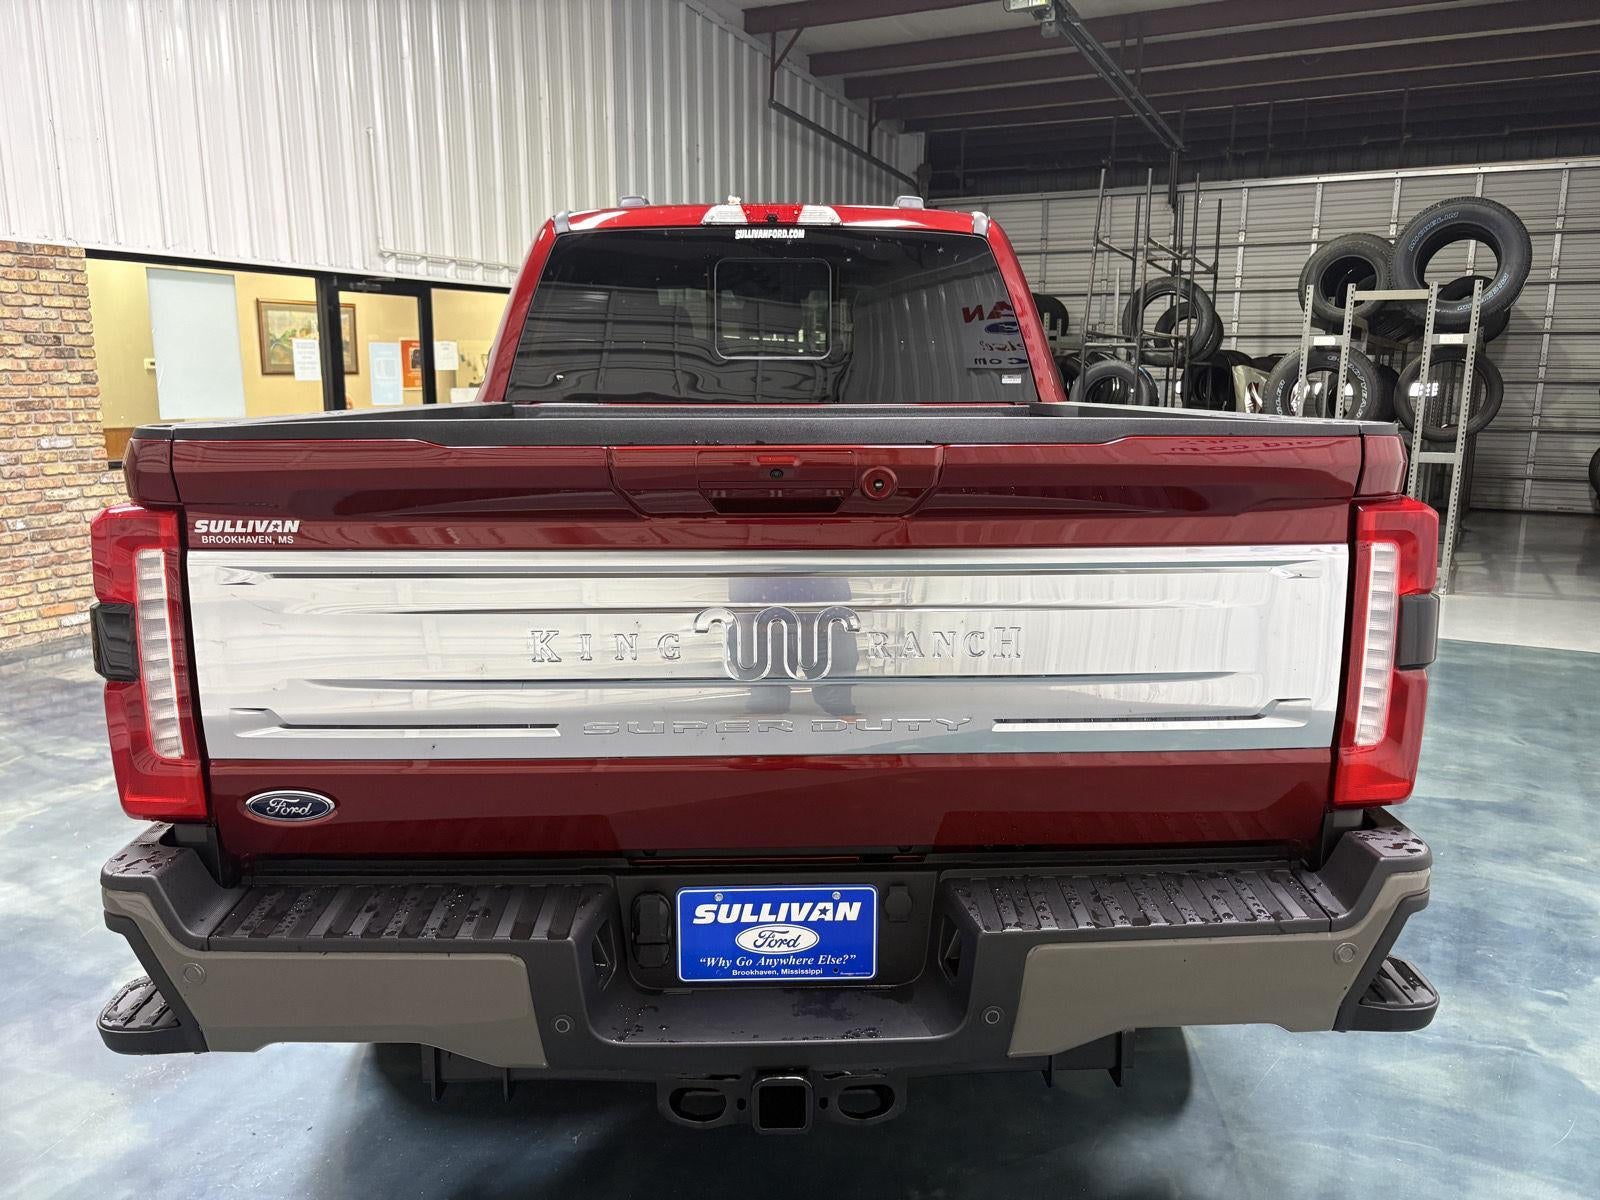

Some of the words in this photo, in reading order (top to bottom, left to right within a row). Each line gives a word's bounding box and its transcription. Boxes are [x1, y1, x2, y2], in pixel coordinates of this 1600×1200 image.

[735, 228, 805, 239] SULLIVANFORD.COM
[194, 520, 300, 533] SULLIVAN
[201, 536, 276, 545] BROOKHAVEN,
[278, 536, 294, 544] MS
[531, 630, 681, 662] KING
[865, 626, 1022, 659] RANCH
[584, 720, 793, 735] SUPER
[811, 718, 972, 732] DUTY
[266, 797, 312, 816] Ford
[693, 902, 861, 924] SULLIVAN
[753, 929, 801, 949] Ford
[736, 956, 753, 966] Go
[756, 956, 814, 967] Anywhere
[781, 968, 823, 976] Mississippi
